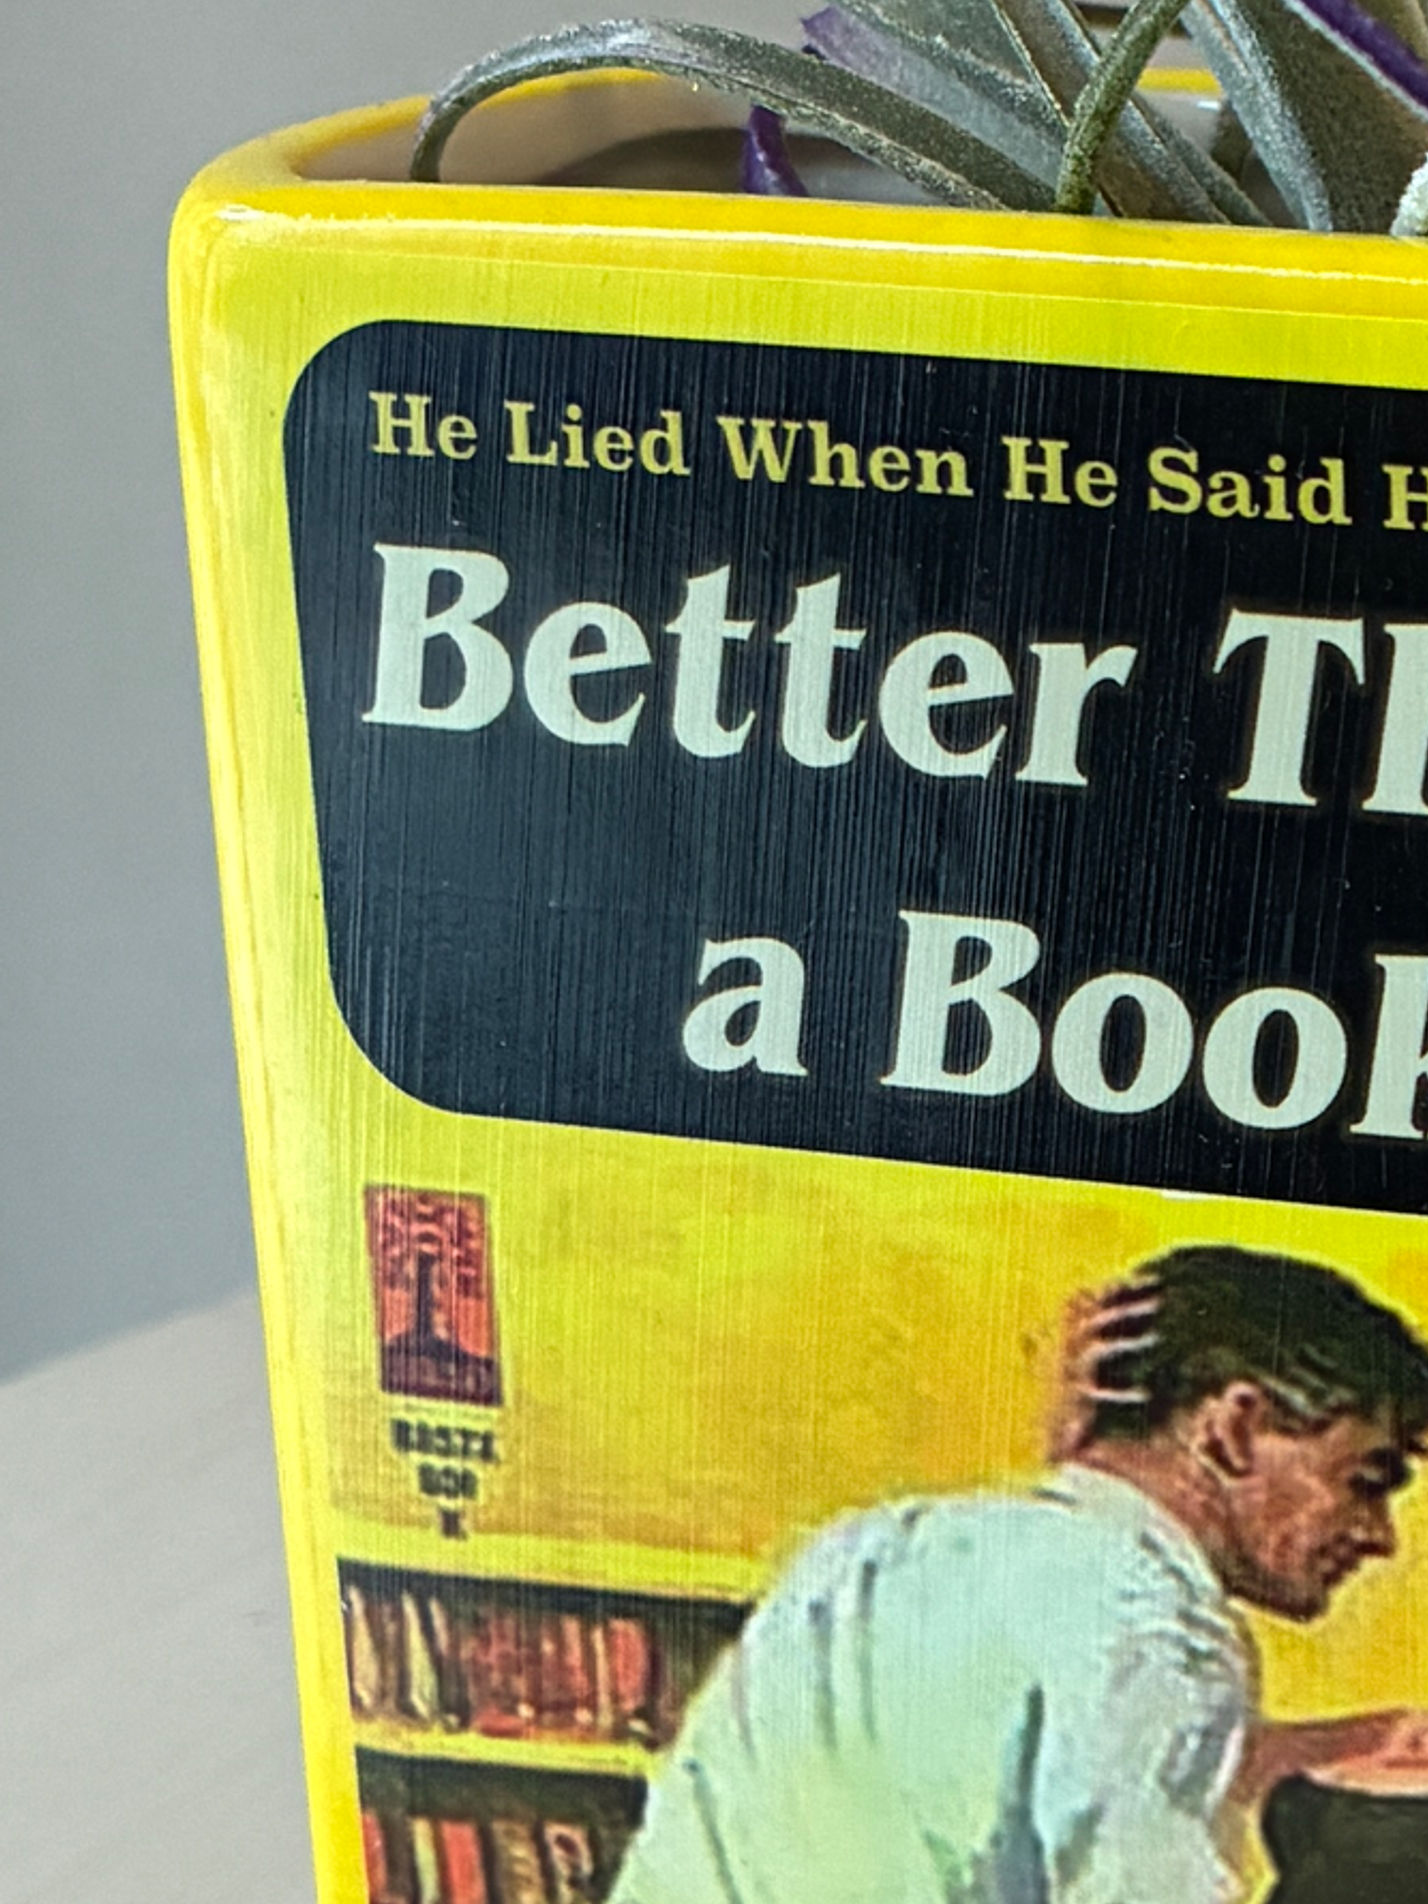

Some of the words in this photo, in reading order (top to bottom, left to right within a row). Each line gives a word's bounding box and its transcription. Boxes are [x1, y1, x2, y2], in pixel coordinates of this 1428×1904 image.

[367, 389, 478, 461] He
[502, 398, 693, 477] Lied
[715, 414, 975, 498] When
[1000, 434, 1119, 508] He
[1147, 446, 1354, 526] Said
[360, 541, 1138, 787] Better
[680, 936, 809, 1078] a
